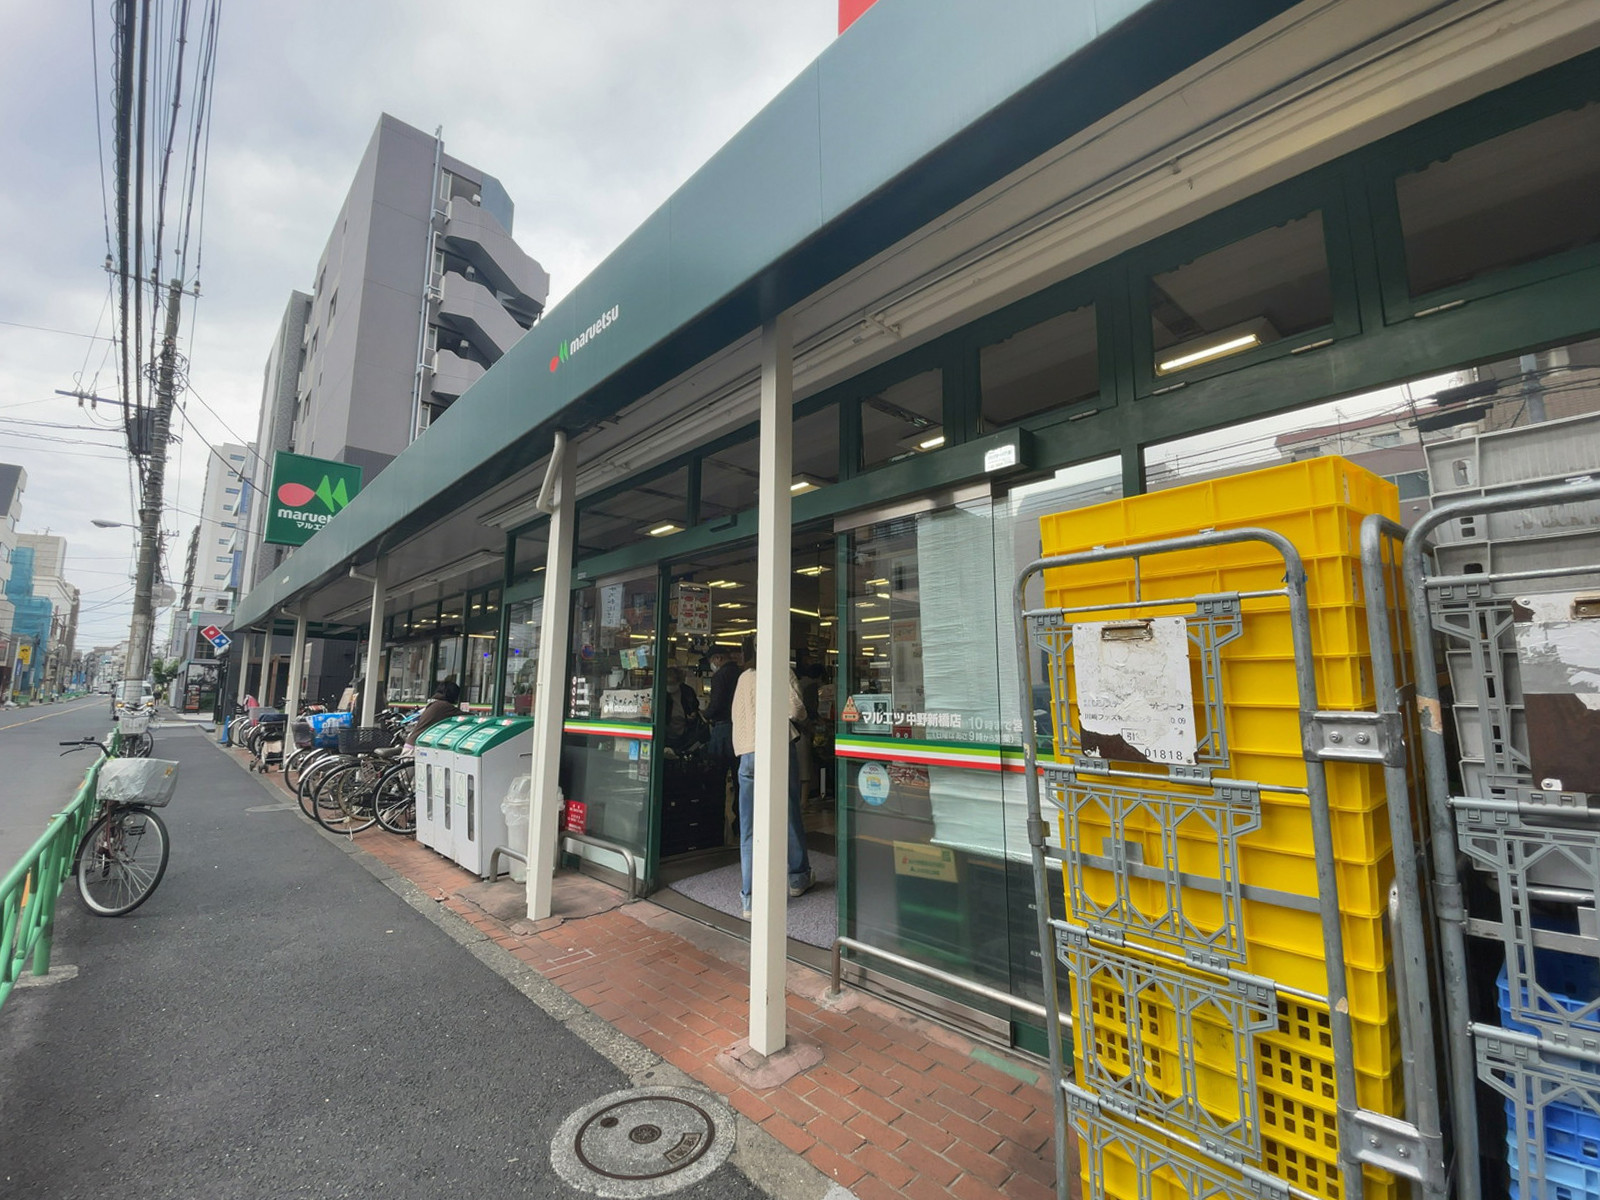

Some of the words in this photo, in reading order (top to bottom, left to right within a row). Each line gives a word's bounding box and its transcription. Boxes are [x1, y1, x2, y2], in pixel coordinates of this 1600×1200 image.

[569, 304, 619, 356] maruetsu
[277, 508, 333, 524] maruet
[861, 711, 905, 725] マルエツ
[1144, 748, 1183, 761] 01818
